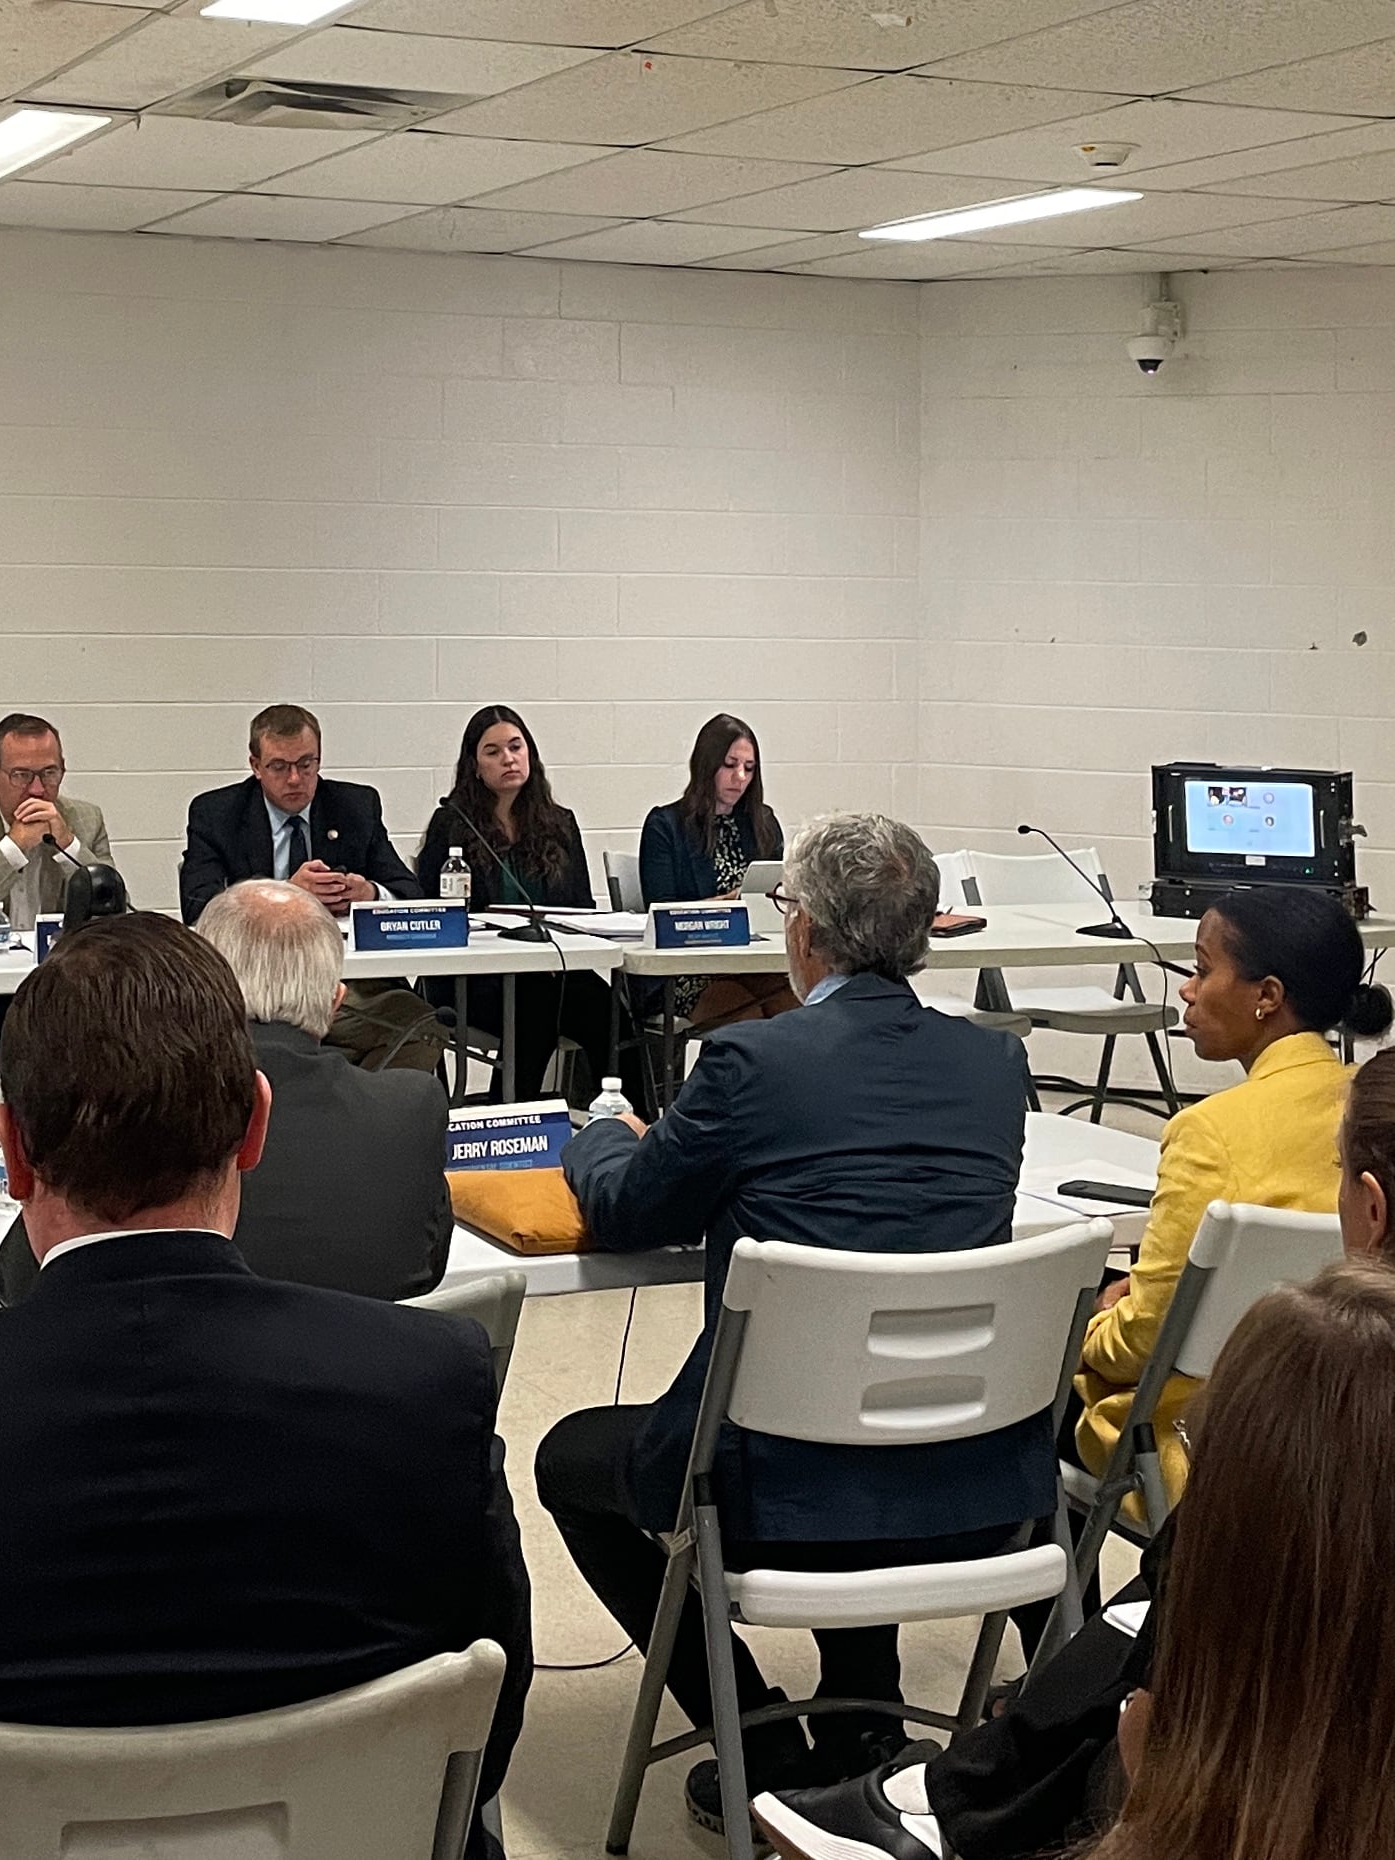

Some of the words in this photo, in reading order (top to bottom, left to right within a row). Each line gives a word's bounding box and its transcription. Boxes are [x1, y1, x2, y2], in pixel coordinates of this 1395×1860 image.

[380, 920, 409, 932] BRYAN
[410, 919, 441, 931] CUTLER
[448, 1120, 484, 1132] CATION
[486, 1114, 542, 1129] COMMITTEE
[451, 1140, 489, 1161] JERRY
[490, 1135, 549, 1157] ROSEMAN
